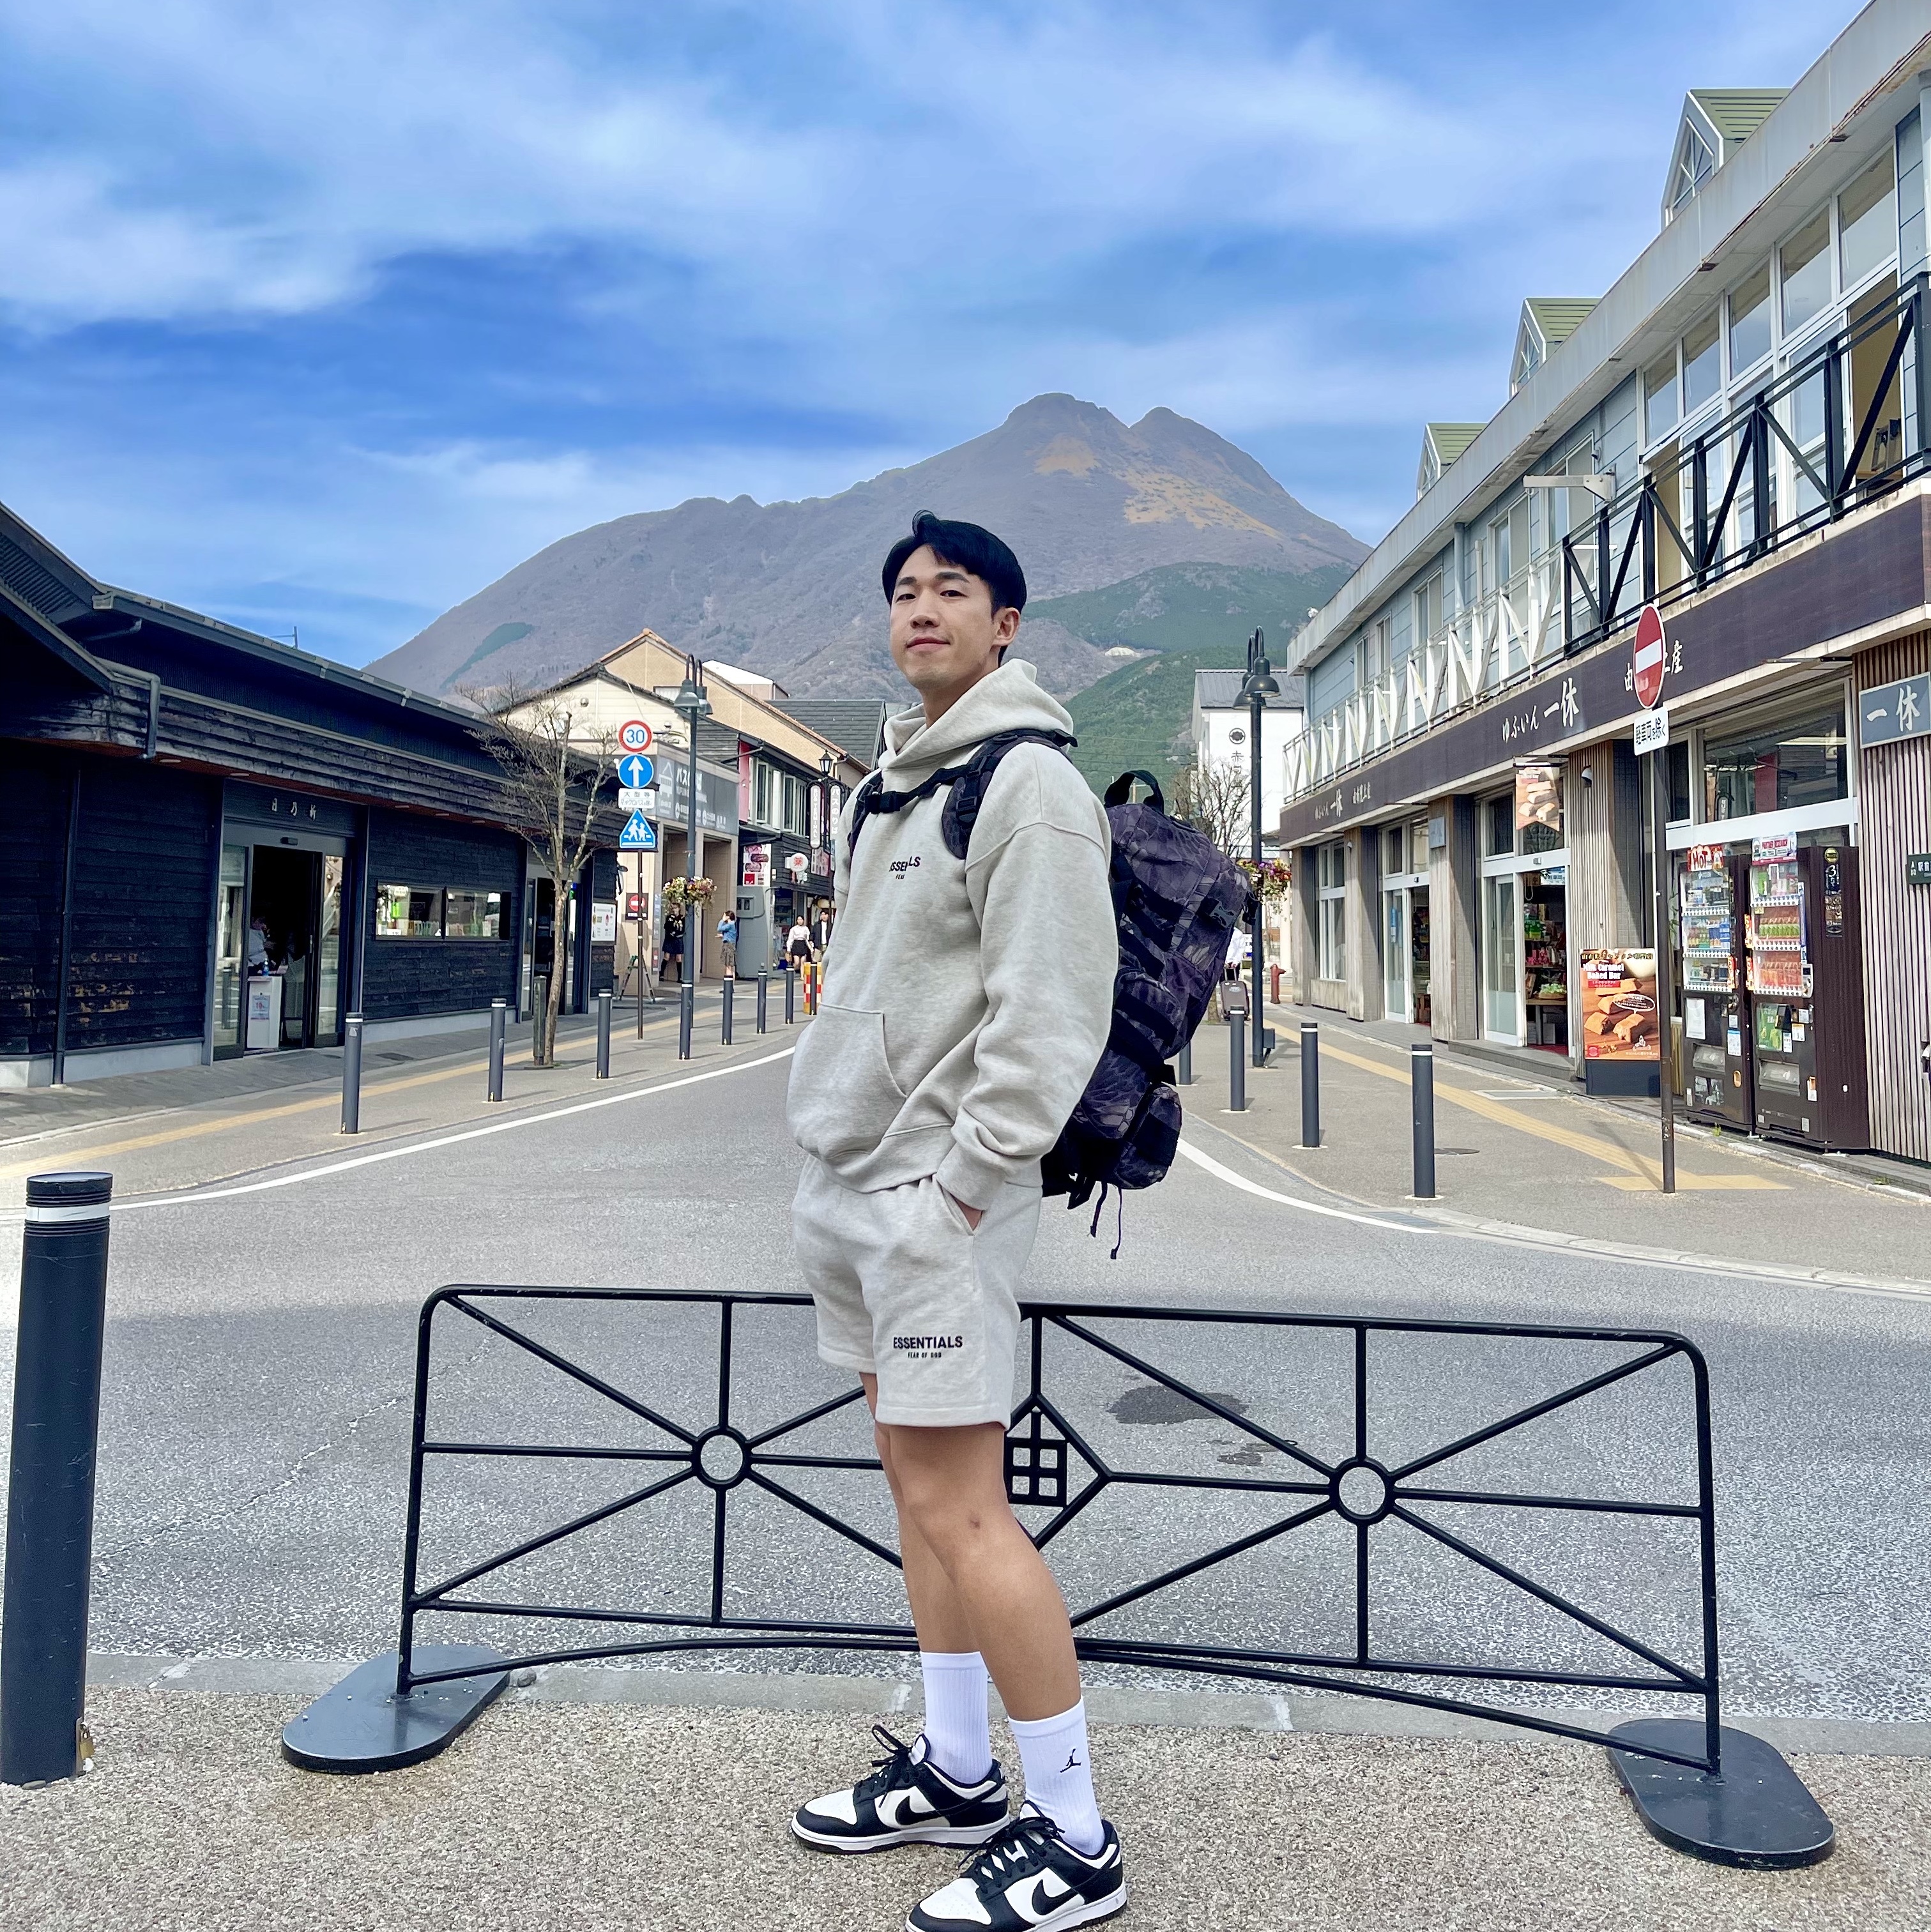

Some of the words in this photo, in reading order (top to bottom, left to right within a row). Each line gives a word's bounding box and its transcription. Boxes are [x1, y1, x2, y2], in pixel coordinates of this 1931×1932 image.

[1502, 705, 1539, 743] ゆふいん
[1543, 677, 1579, 727] 一休
[1866, 685, 1920, 732] 一休
[626, 729, 645, 743] 30
[831, 788, 840, 835] バスのりば
[1330, 788, 1343, 818] 一休
[893, 1335, 963, 1349] ESSENTIALS
